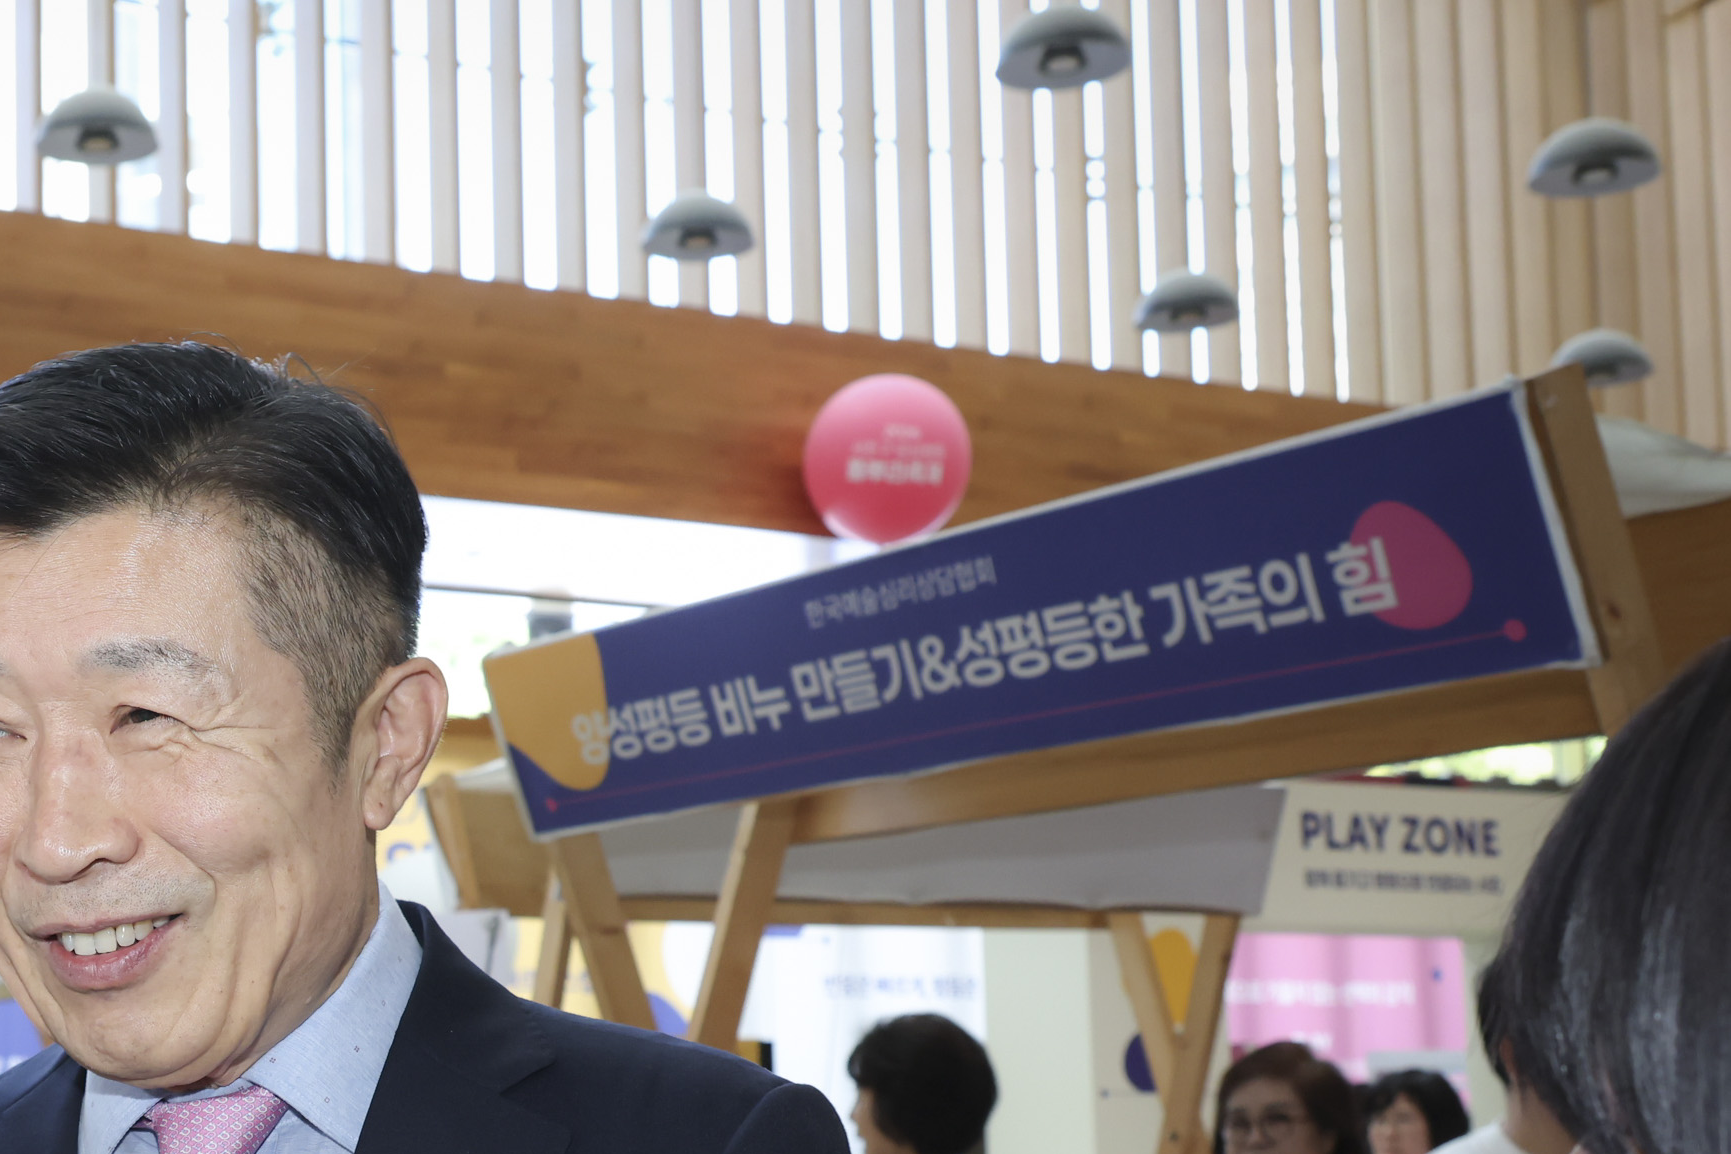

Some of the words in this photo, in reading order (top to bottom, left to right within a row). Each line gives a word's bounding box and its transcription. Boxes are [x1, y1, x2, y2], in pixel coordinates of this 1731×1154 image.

[572, 687, 711, 765] 양성평등
[711, 674, 793, 737] 비누
[791, 591, 1150, 724] 만들기&성평등한
[1149, 552, 1325, 648] 가족의
[1325, 536, 1399, 617] 힘
[1300, 810, 1390, 851] PLAY
[1401, 816, 1501, 857] ZONE
